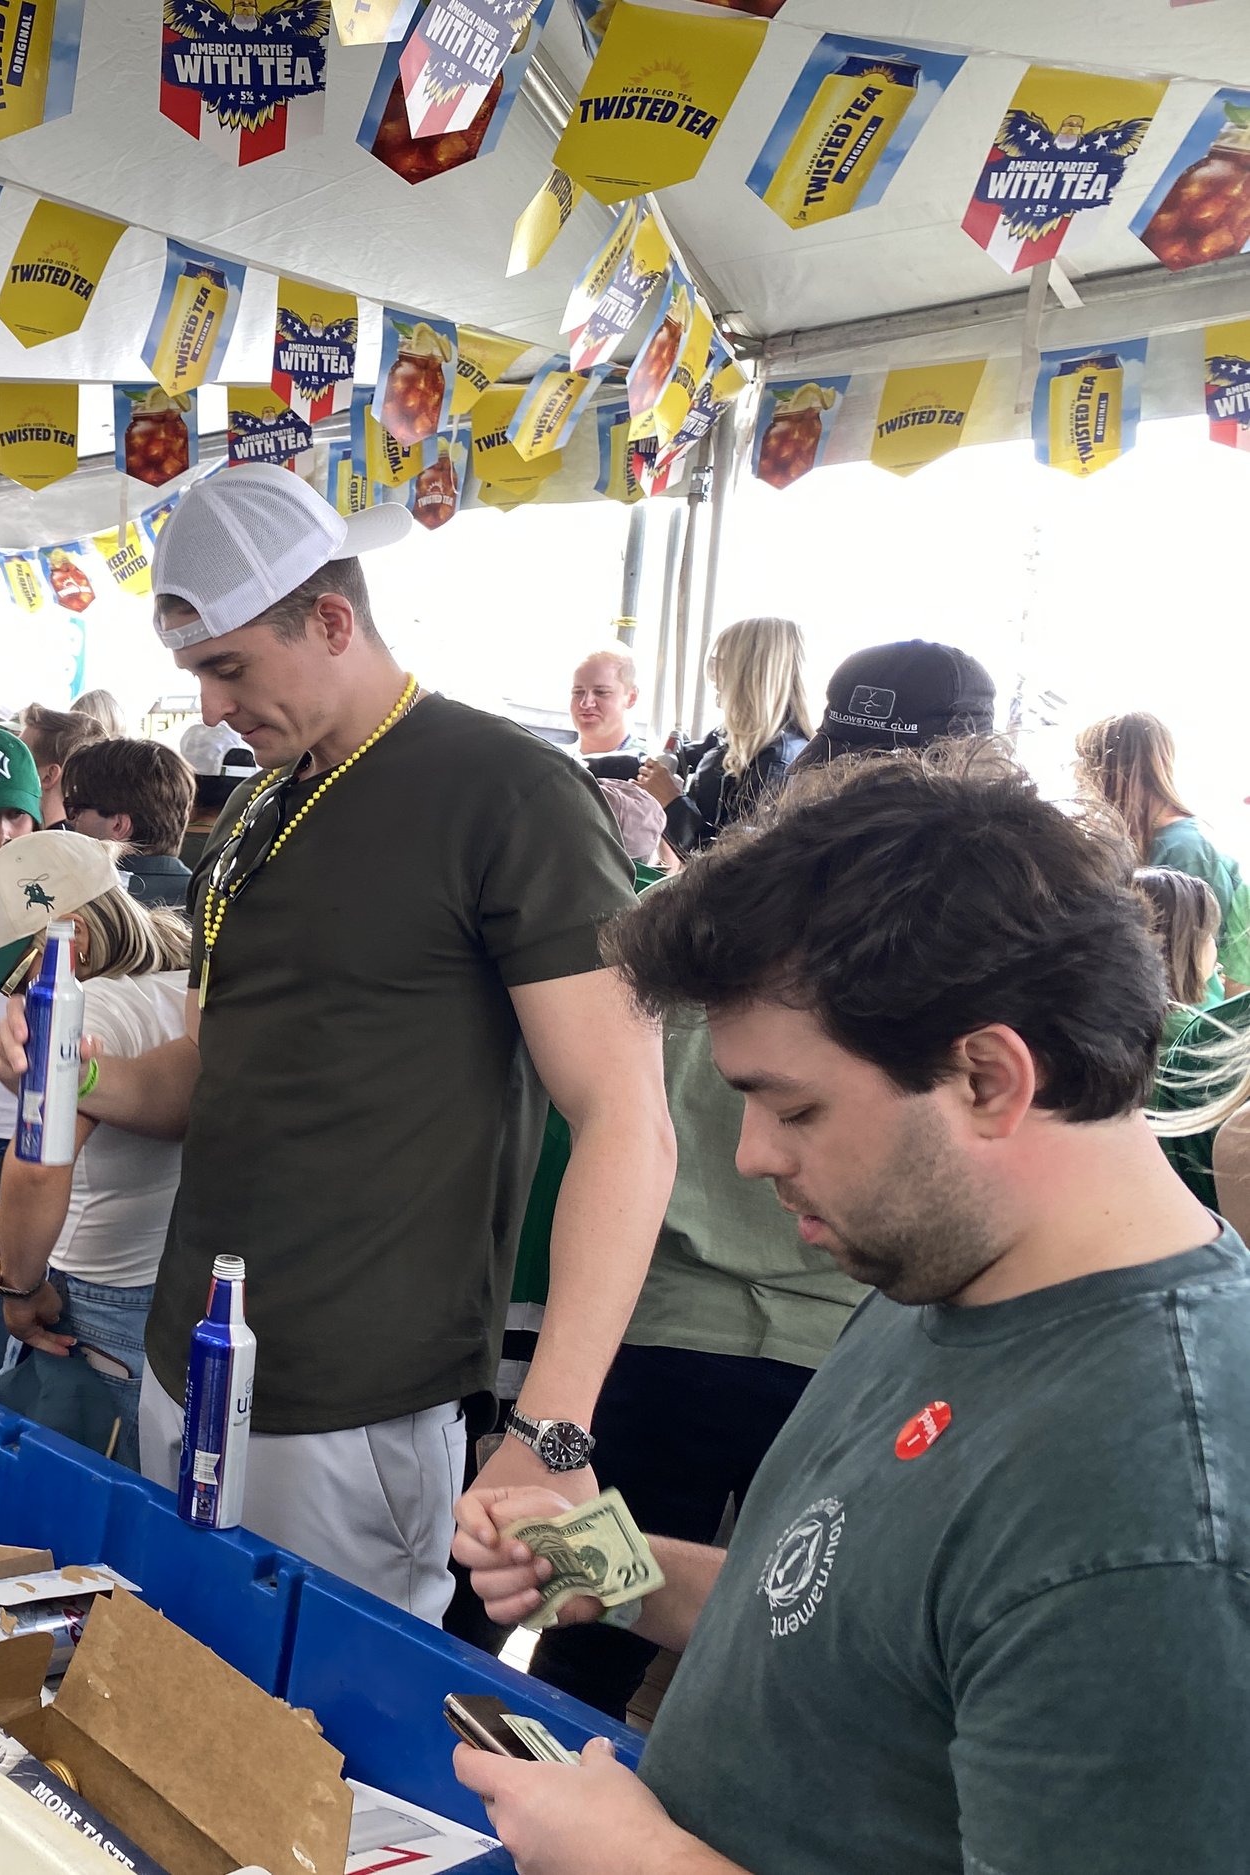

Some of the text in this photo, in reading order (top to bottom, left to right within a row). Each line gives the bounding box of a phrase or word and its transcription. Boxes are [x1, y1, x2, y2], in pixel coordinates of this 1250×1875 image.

[447, 0, 499, 42] AMERICA PARTIES
[13, 14, 32, 74] ORIGINAL
[189, 42, 293, 58] AMERICA PARTIES
[425, 4, 474, 58] WITH
[466, 37, 500, 78] TEA
[173, 54, 315, 86] WITH TEA
[240, 91, 255, 101] 5%
[622, 86, 694, 103] HARD ICED TEA
[579, 98, 720, 140] TWISTED TEA
[804, 86, 883, 206] TWISTED TEA
[805, 114, 841, 175] HARD ICED TEA
[841, 126, 877, 174] ORIGINAL
[1007, 160, 1098, 173] AMERICA PARTIES
[987, 173, 1109, 201] WITH TEA
[11, 264, 94, 301] TWISTED TEA
[174, 311, 197, 378] TWISTED
[191, 286, 211, 312] TEA
[193, 318, 212, 356] ORIGINAL
[279, 351, 349, 374] WITH TEA
[288, 343, 340, 354] AMERICA PARTIES
[470, 369, 490, 392] TEA
[532, 395, 558, 446] TWISTED
[556, 378, 574, 396] TEA
[877, 410, 966, 438] TWISTED TEA
[1075, 376, 1097, 464] TWISTED TEA
[1096, 399, 1107, 435] ORIGINAL
[52, 430, 76, 448] TEA
[234, 432, 308, 459] WITH TEA
[242, 427, 296, 443] AMERICA PARTIES
[106, 543, 136, 570] KEEP IT
[111, 555, 148, 585] TWISTED
[829, 709, 918, 731] YELLOWSTONE CLUB
[770, 1512, 845, 1639] Tournament
[30, 1781, 80, 1828] MORE
